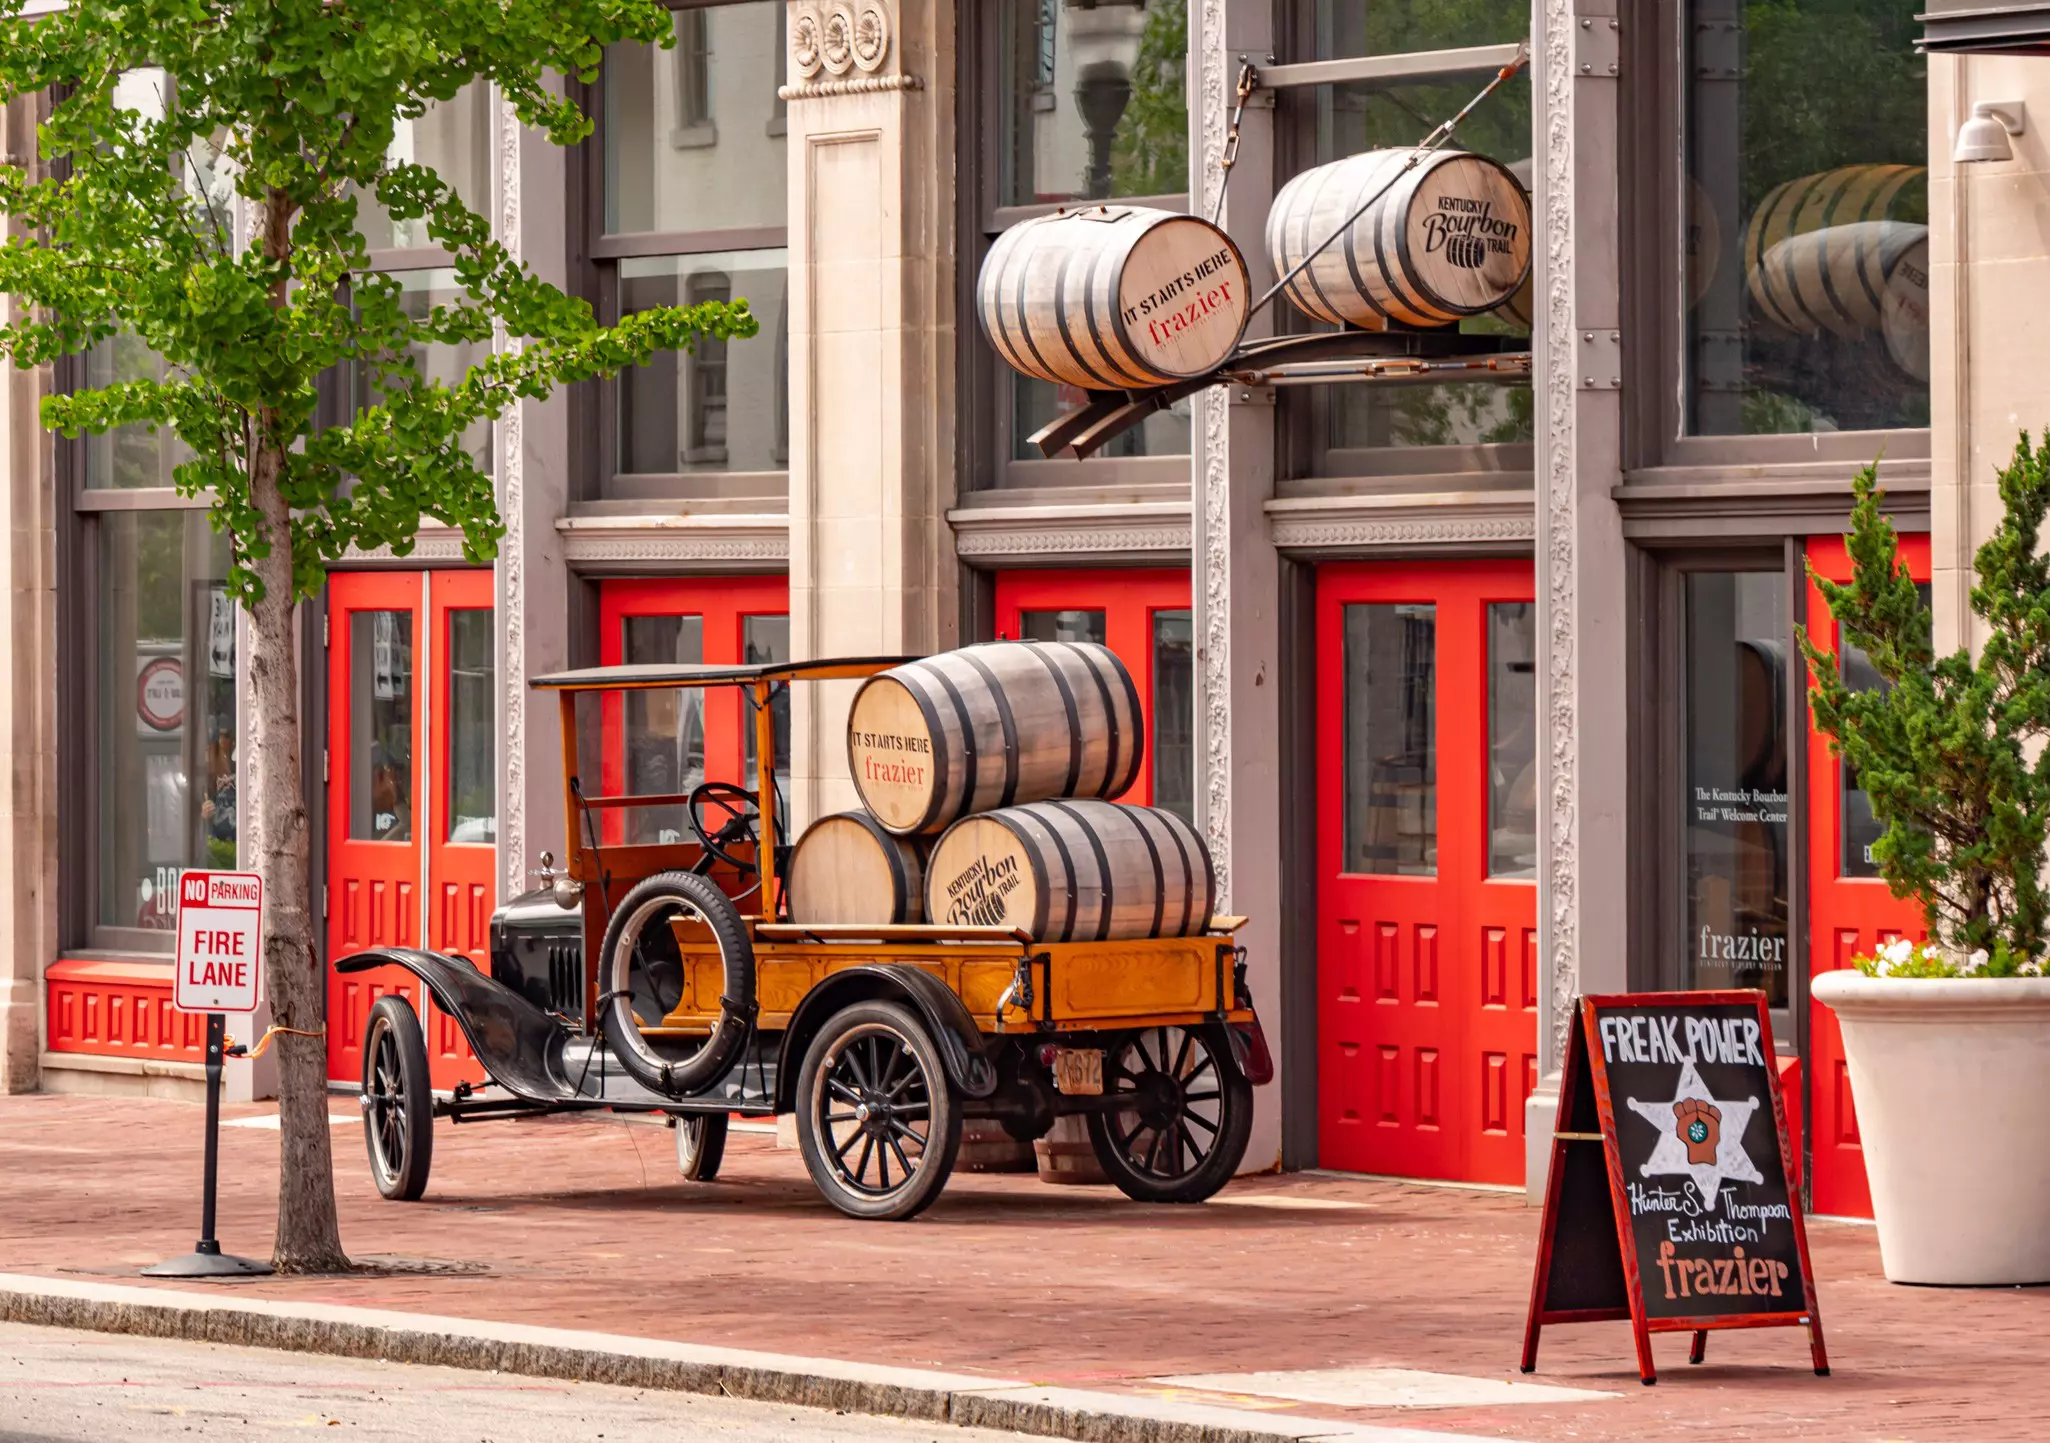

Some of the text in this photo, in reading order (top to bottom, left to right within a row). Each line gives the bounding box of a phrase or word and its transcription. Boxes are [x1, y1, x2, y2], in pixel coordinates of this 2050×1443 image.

[1438, 196, 1483, 213] KENTUCKY
[1422, 201, 1518, 253] Bourbon
[1486, 237, 1513, 254] TRAIL
[1124, 248, 1232, 325] IT STARTS HERE
[1148, 281, 1231, 346] frazier
[852, 732, 930, 753] IT STARTS HERE
[865, 754, 924, 785] frazier
[1695, 787, 1710, 800] The
[1712, 787, 1751, 806] Kentucky
[1721, 808, 1758, 822] Welcome
[1759, 809, 1788, 822] Center
[185, 879, 258, 901] NO PARKING
[946, 859, 983, 898] KENTUCKY
[946, 854, 1018, 926] Bourbon
[998, 874, 1021, 897] TRAIL
[194, 930, 245, 956] FIRE
[1700, 924, 1785, 962] frazier
[189, 961, 247, 987] LANE
[1599, 1015, 1765, 1067] FREAK POWER
[1627, 1181, 1791, 1235] Hunter S. Thompson
[1667, 1218, 1759, 1243] Exhibition
[1656, 1240, 1789, 1299] frazier
